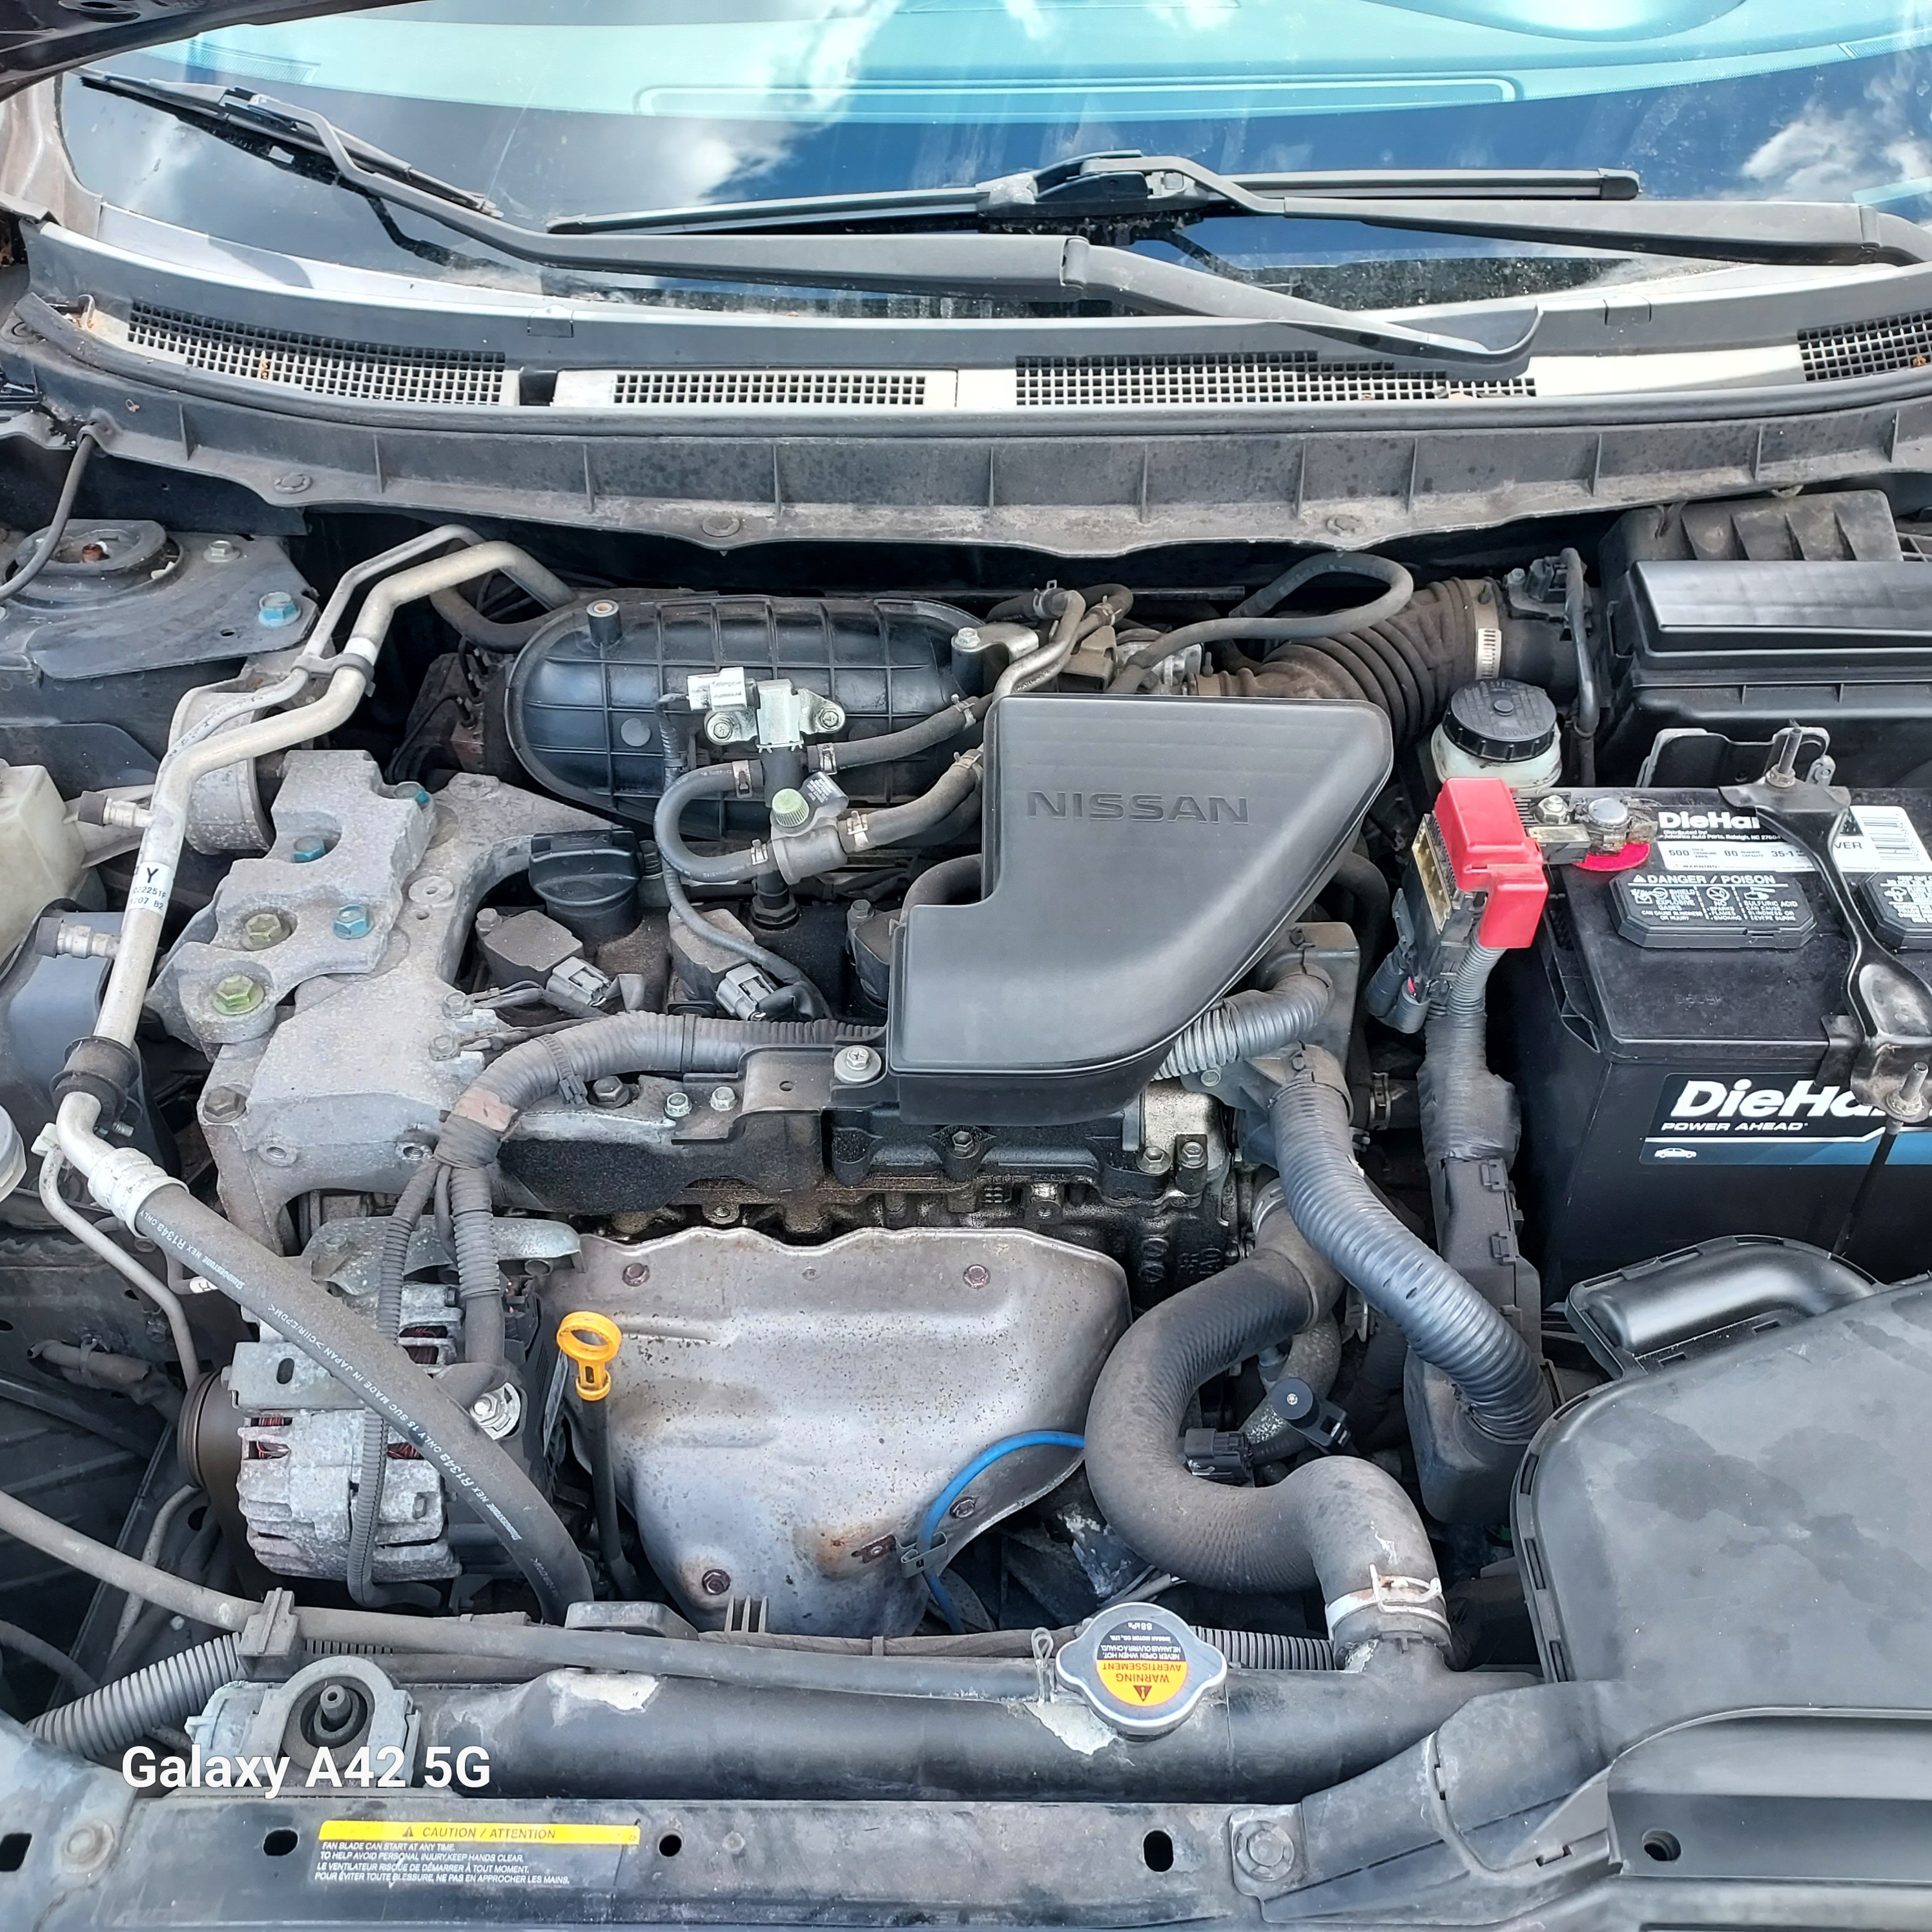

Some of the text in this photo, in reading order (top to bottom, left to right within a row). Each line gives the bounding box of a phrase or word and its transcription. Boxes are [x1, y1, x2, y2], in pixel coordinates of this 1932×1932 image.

[1027, 790, 1249, 825] NISSAN
[147, 867, 159, 883] Y
[1647, 875, 1707, 884] DANGER
[1721, 875, 1776, 885] POISON
[154, 900, 163, 910] B2
[1661, 1122, 1731, 1131] POWER
[138, 1209, 157, 1226] ONLY
[156, 1222, 187, 1250] R134a
[187, 1245, 202, 1259] NEX
[323, 1346, 354, 1372] JAPAN
[353, 1368, 364, 1382] IN
[364, 1381, 390, 1404] MADE
[389, 1403, 409, 1421] SUC
[407, 1420, 420, 1432] 15
[417, 1432, 442, 1453] ONLY
[440, 1452, 475, 1486] R134a
[472, 1486, 489, 1503] NEX
[1102, 1663, 1182, 1672] AVERTISSEMENT
[1115, 1673, 1169, 1683] WARNING
[423, 1827, 556, 1839] CAUTION / ATTENTION
[322, 1842, 338, 1850] FAN
[338, 1842, 364, 1850] BLADE
[365, 1842, 382, 1851] CAN
[320, 1851, 331, 1860] TO
[353, 1852, 377, 1860] AVOID
[497, 1854, 524, 1862] CLEAR.
[328, 1863, 378, 1871] VENTILATEUR
[378, 1864, 409, 1872] RISQUE
[422, 1862, 464, 1872] DÉMARRER
[464, 1862, 471, 1872] À
[494, 1865, 529, 1873] MOMENT.
[339, 1871, 364, 1881] ÉVITER
[366, 1873, 391, 1881] TOUTE
[392, 1873, 434, 1882] BLESSURE,
[464, 1874, 475, 1882] EN
[477, 1875, 527, 1884] APPROCHER
[527, 1875, 542, 1884] LES
[544, 1876, 570, 1885] MAINS.
